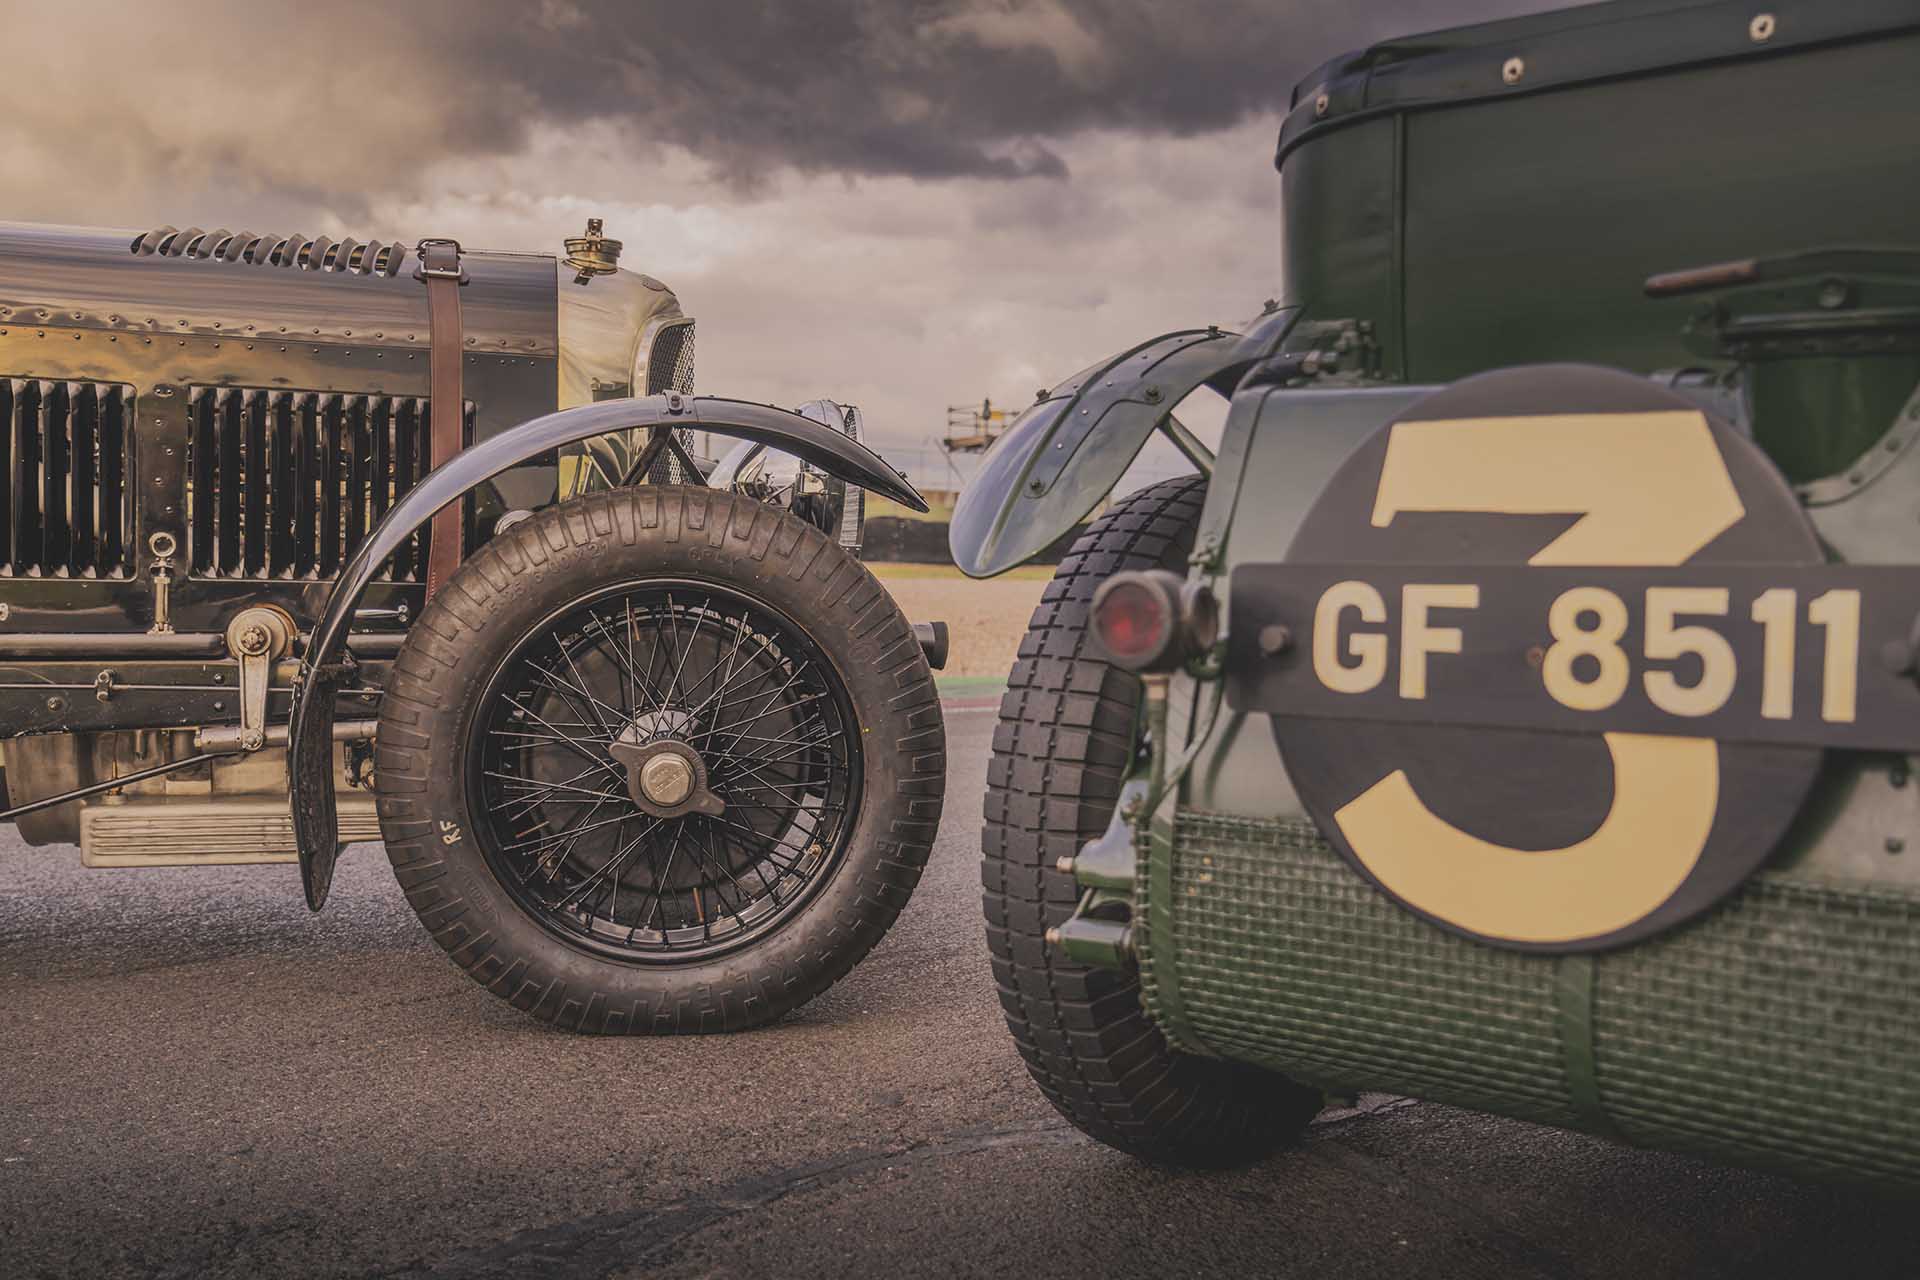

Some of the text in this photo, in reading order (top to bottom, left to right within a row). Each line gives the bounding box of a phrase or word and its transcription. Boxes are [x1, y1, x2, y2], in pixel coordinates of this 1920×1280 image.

[1313, 581, 1860, 722] GF 8511
[1334, 410, 1746, 942] 3
[440, 821, 462, 845] RF
